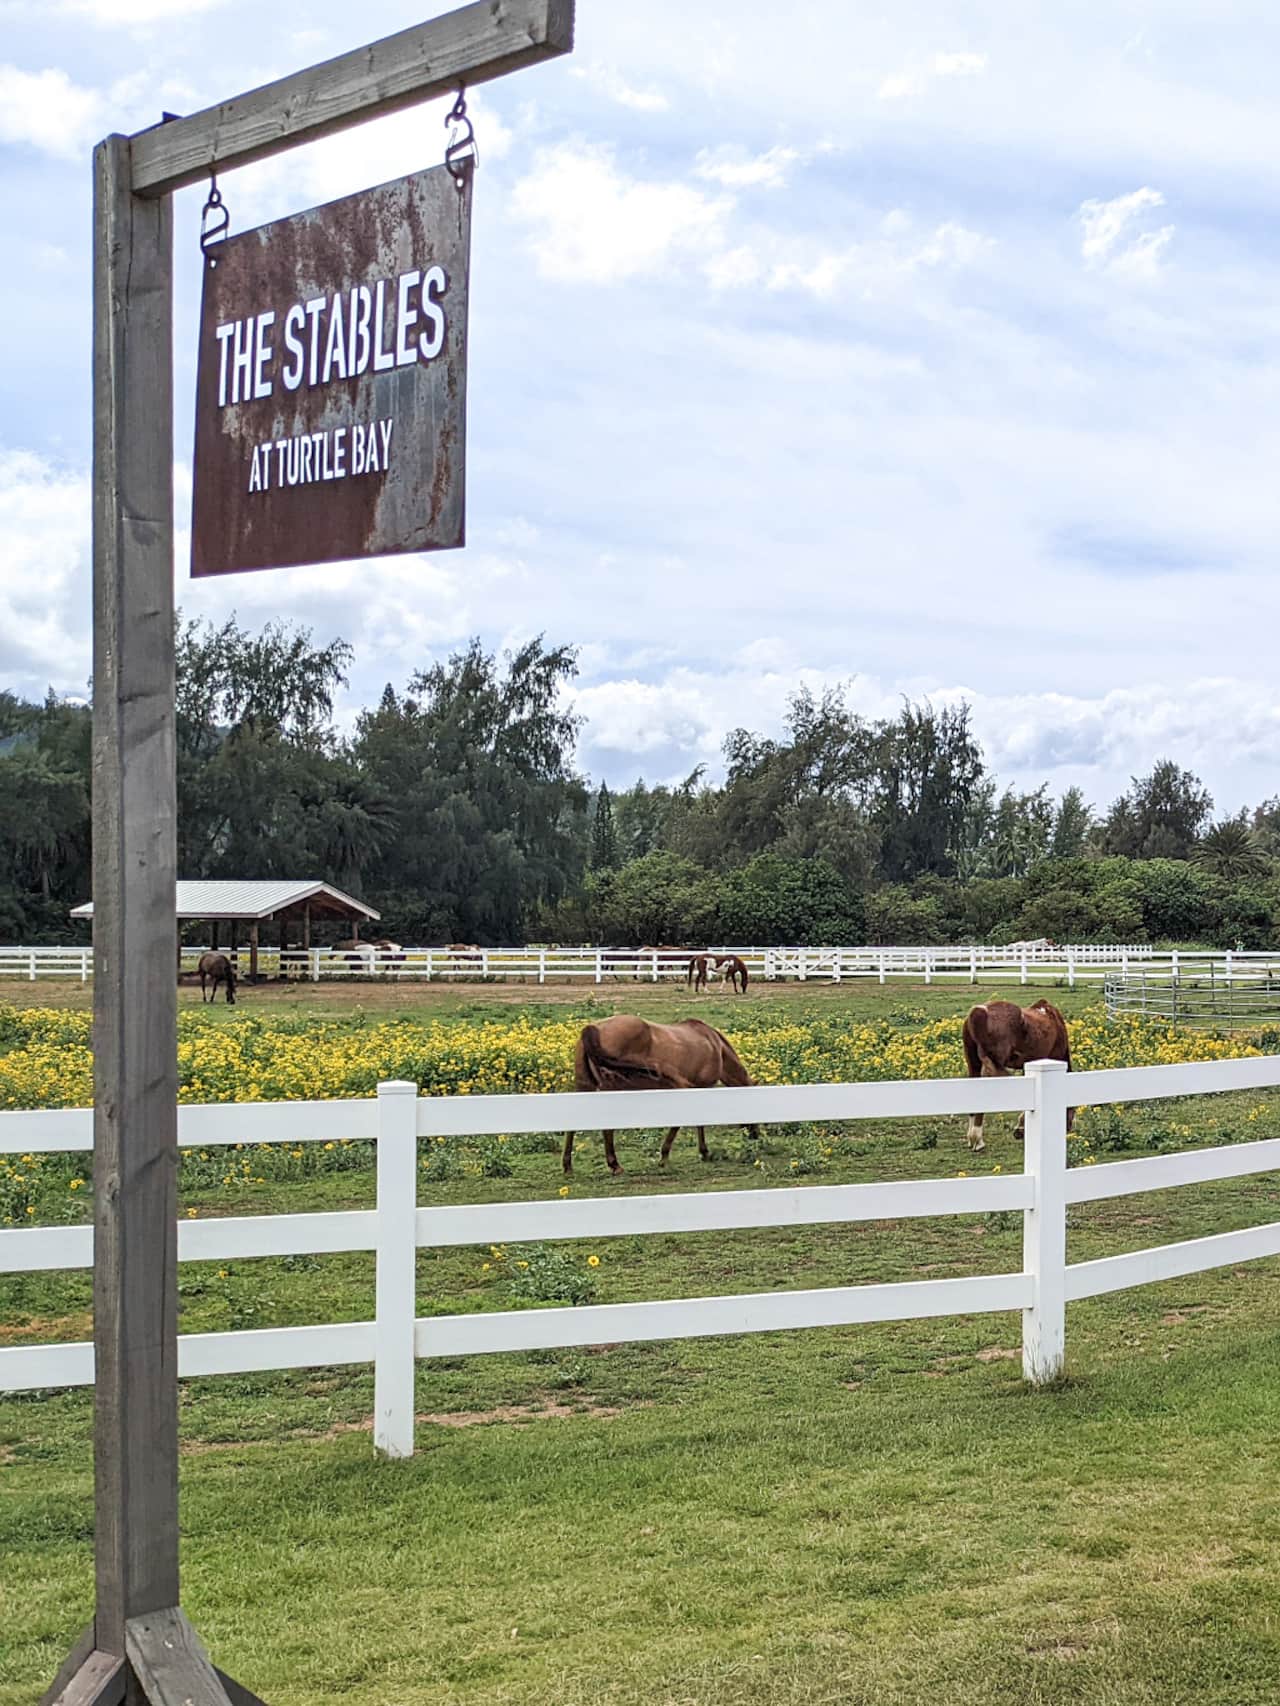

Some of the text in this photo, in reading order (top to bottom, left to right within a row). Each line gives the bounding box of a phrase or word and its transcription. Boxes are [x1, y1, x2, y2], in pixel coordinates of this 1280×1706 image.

[216, 265, 446, 406] THE STABLES
[248, 419, 394, 493] AT TURTLE BAY
